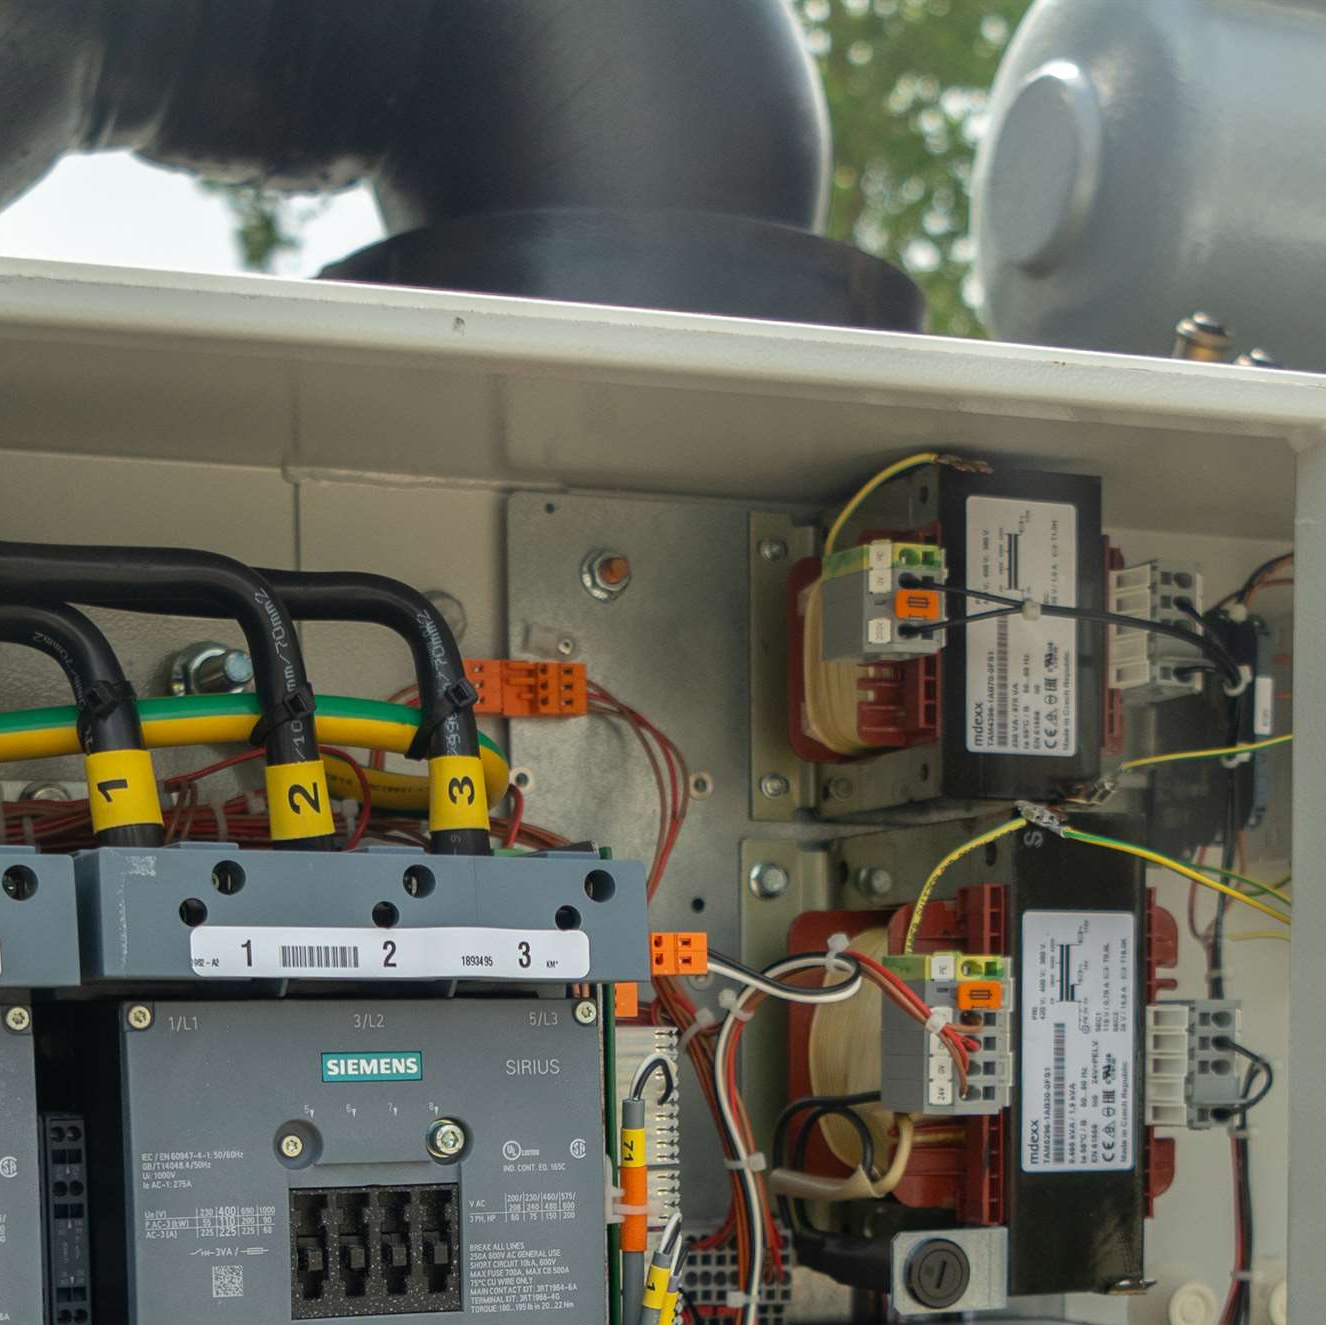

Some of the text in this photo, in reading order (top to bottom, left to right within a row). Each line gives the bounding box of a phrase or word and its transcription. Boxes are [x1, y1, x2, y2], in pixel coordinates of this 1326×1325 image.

[972, 703, 983, 746] mdexx
[97, 779, 128, 802] 1
[288, 782, 321, 814] 2
[448, 776, 475, 806] 3
[241, 940, 252, 967] 1
[383, 941, 396, 967] 2
[461, 956, 493, 967] 1893495
[518, 942, 531, 968] 3
[168, 1012, 558, 1030] 1/L1 3/L2 5/L3
[327, 1058, 560, 1076] SIEMENS SIRIUS
[624, 1140, 634, 1161] 71
[1028, 1120, 1039, 1164] mdexx
[219, 1207, 236, 1215] 400
[219, 1228, 236, 1237] 225
